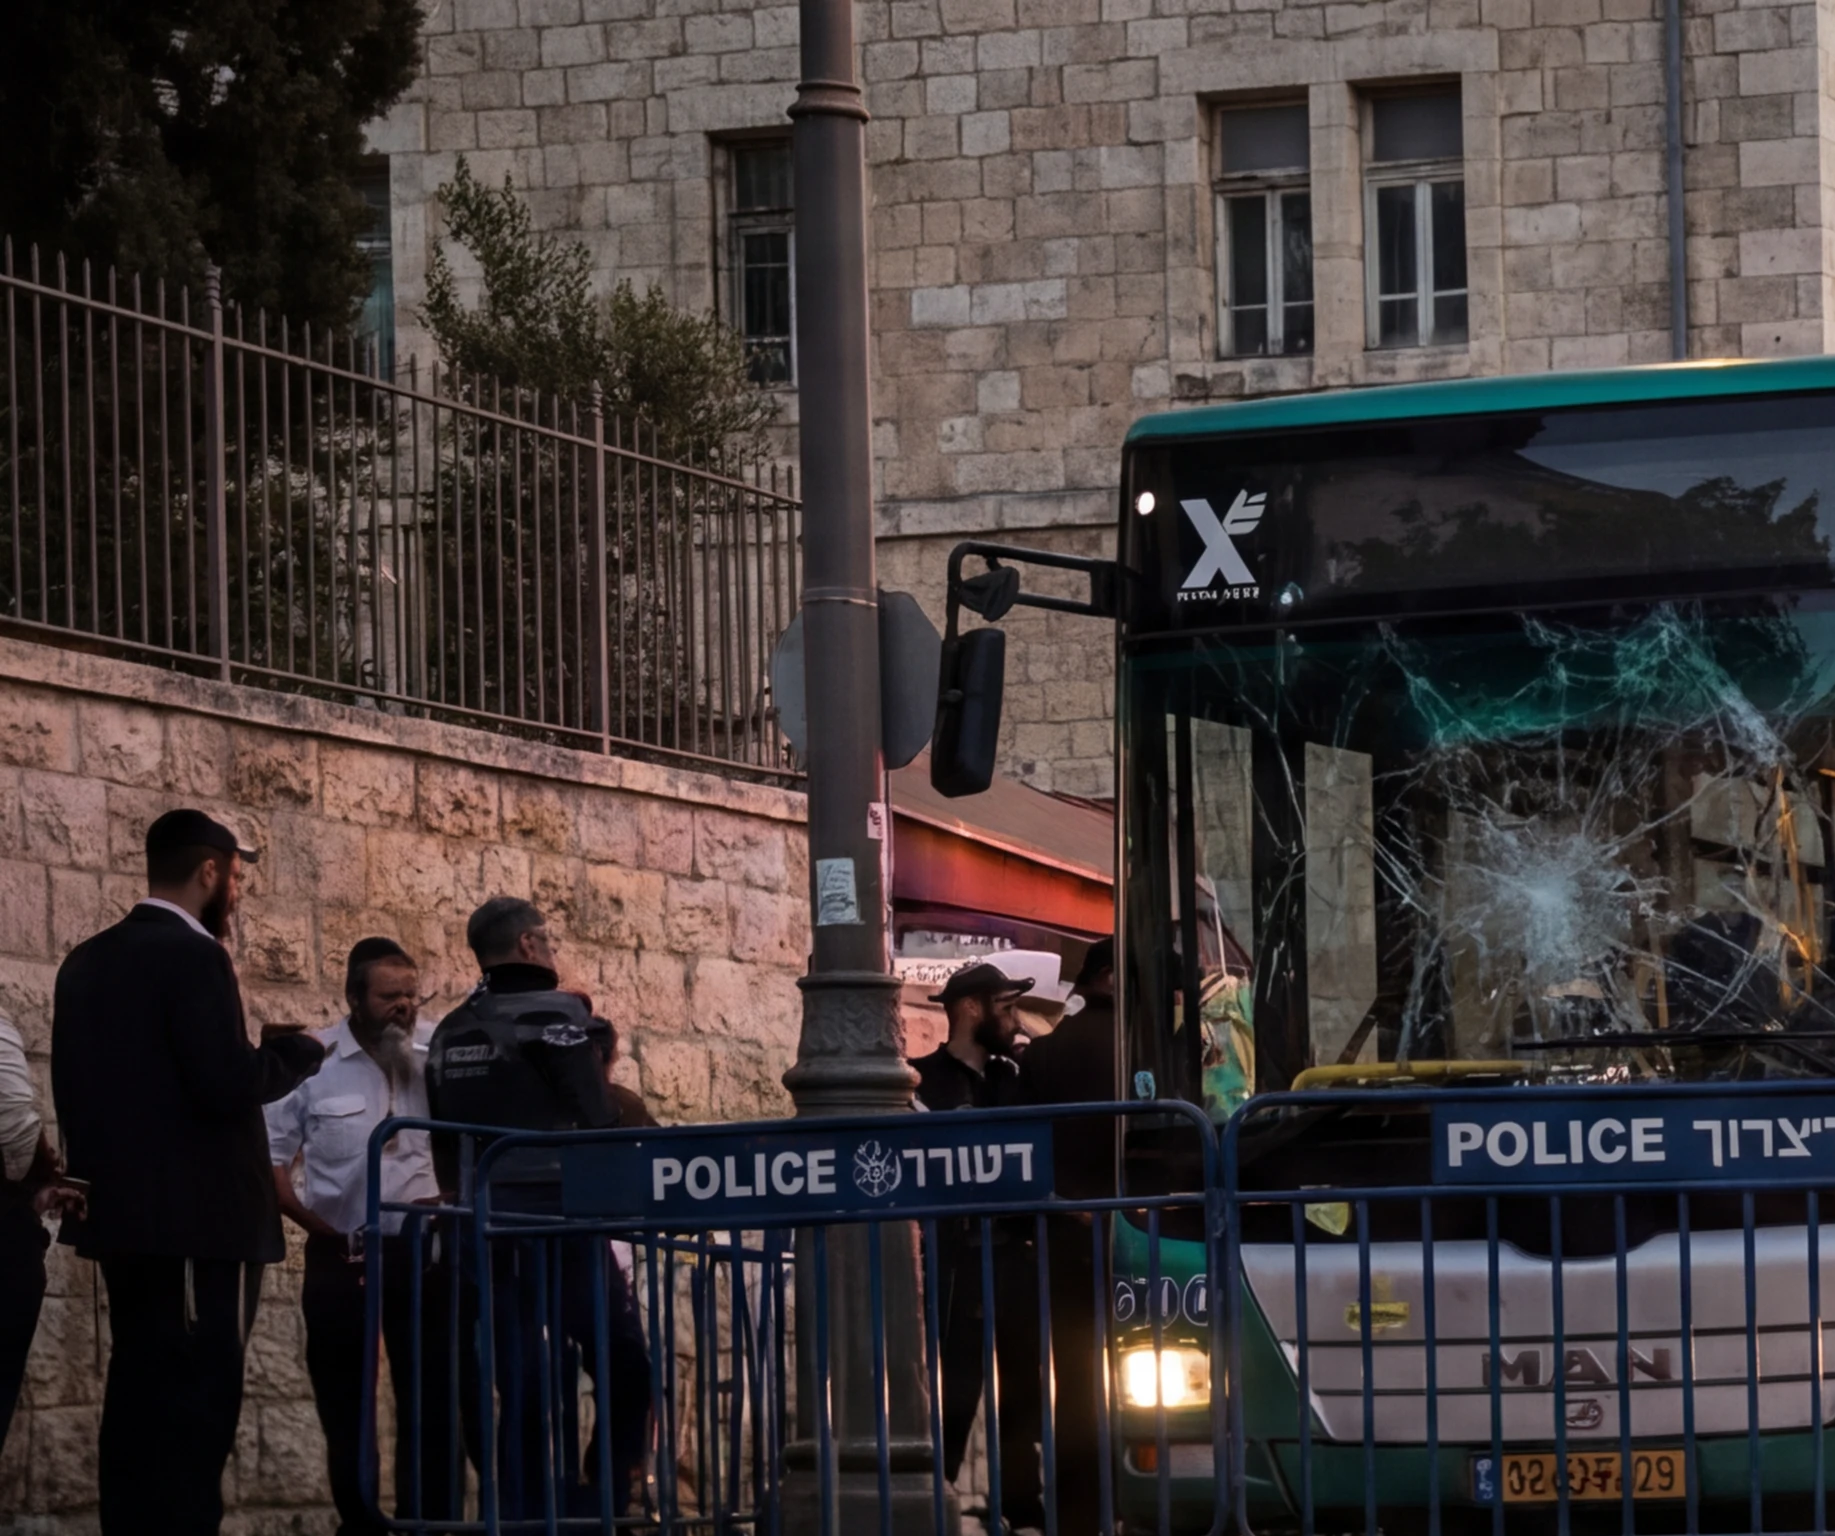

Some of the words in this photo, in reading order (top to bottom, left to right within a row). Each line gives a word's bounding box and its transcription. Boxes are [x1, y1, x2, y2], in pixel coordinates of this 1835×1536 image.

[1447, 1117, 1667, 1168] POLICE
[652, 1149, 837, 1201] POLICE
[1481, 1347, 1674, 1388] MAN
